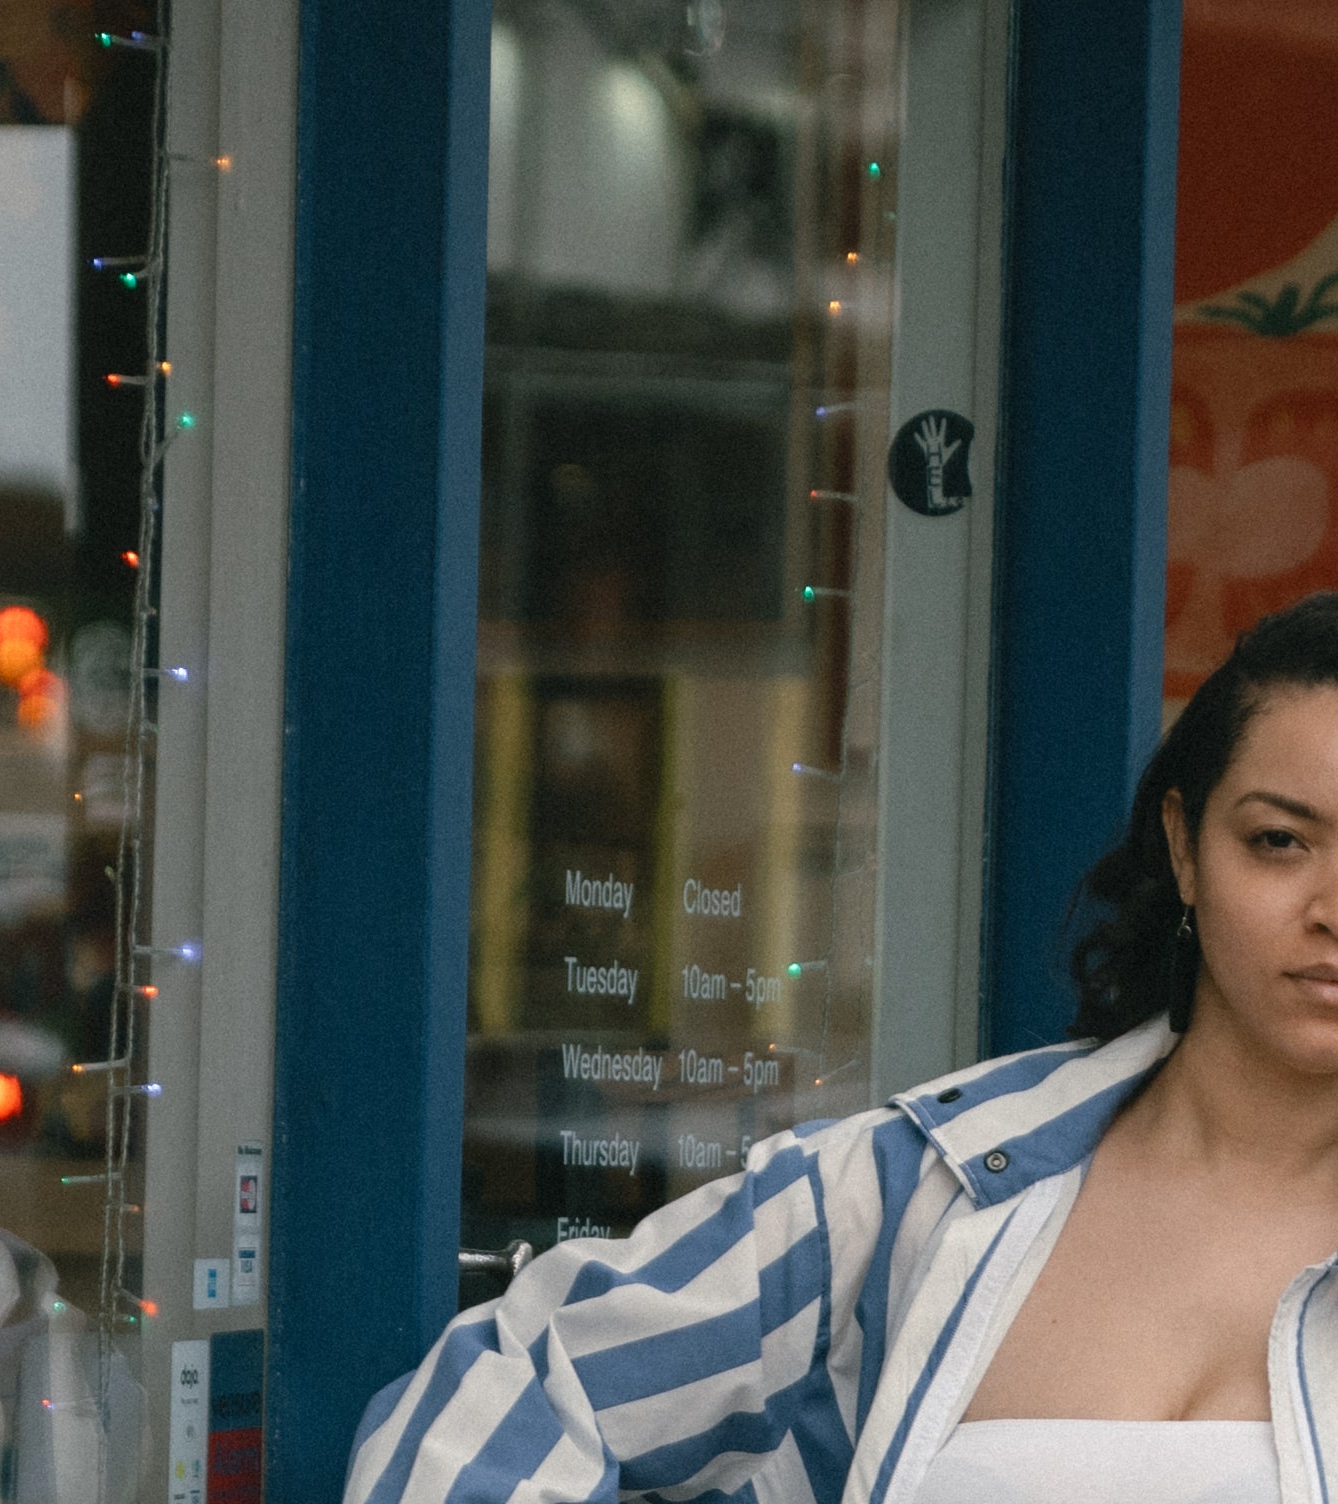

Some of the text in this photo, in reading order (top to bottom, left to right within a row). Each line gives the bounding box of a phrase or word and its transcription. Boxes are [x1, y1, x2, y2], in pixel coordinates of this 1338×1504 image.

[564, 869, 743, 918] Monday Closed
[564, 956, 638, 1004] Tuesday
[681, 964, 726, 1000] 10am
[745, 967, 782, 1006] 5pm
[561, 1042, 662, 1091] Wednesday
[678, 1049, 723, 1086] 10am
[742, 1051, 779, 1093] 5pm
[560, 1129, 640, 1177] Thursday
[677, 1134, 722, 1169] 10am
